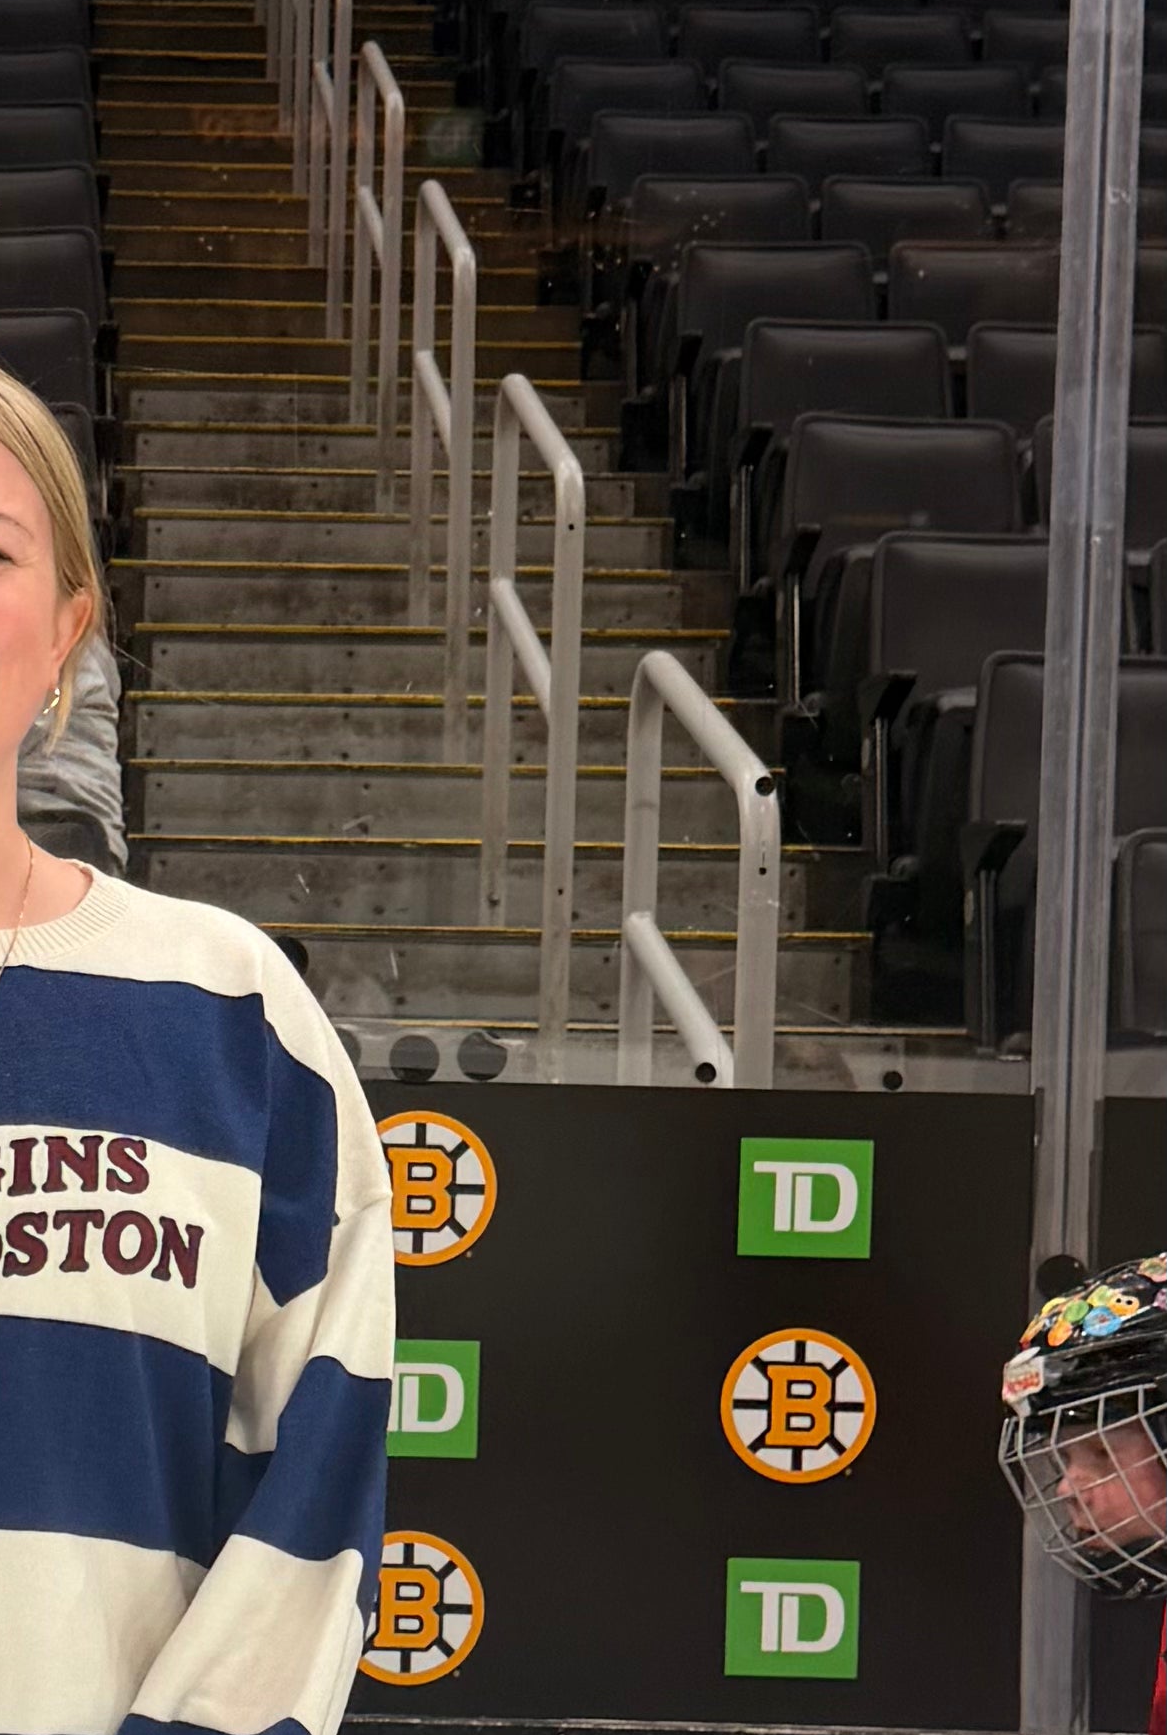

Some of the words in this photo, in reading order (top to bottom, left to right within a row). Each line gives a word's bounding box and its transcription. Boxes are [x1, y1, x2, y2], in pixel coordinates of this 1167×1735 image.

[387, 1147, 453, 1230] B
[753, 1160, 858, 1234] TD
[766, 1363, 838, 1448] B
[373, 1567, 441, 1649] B
[739, 1581, 845, 1653] TD
